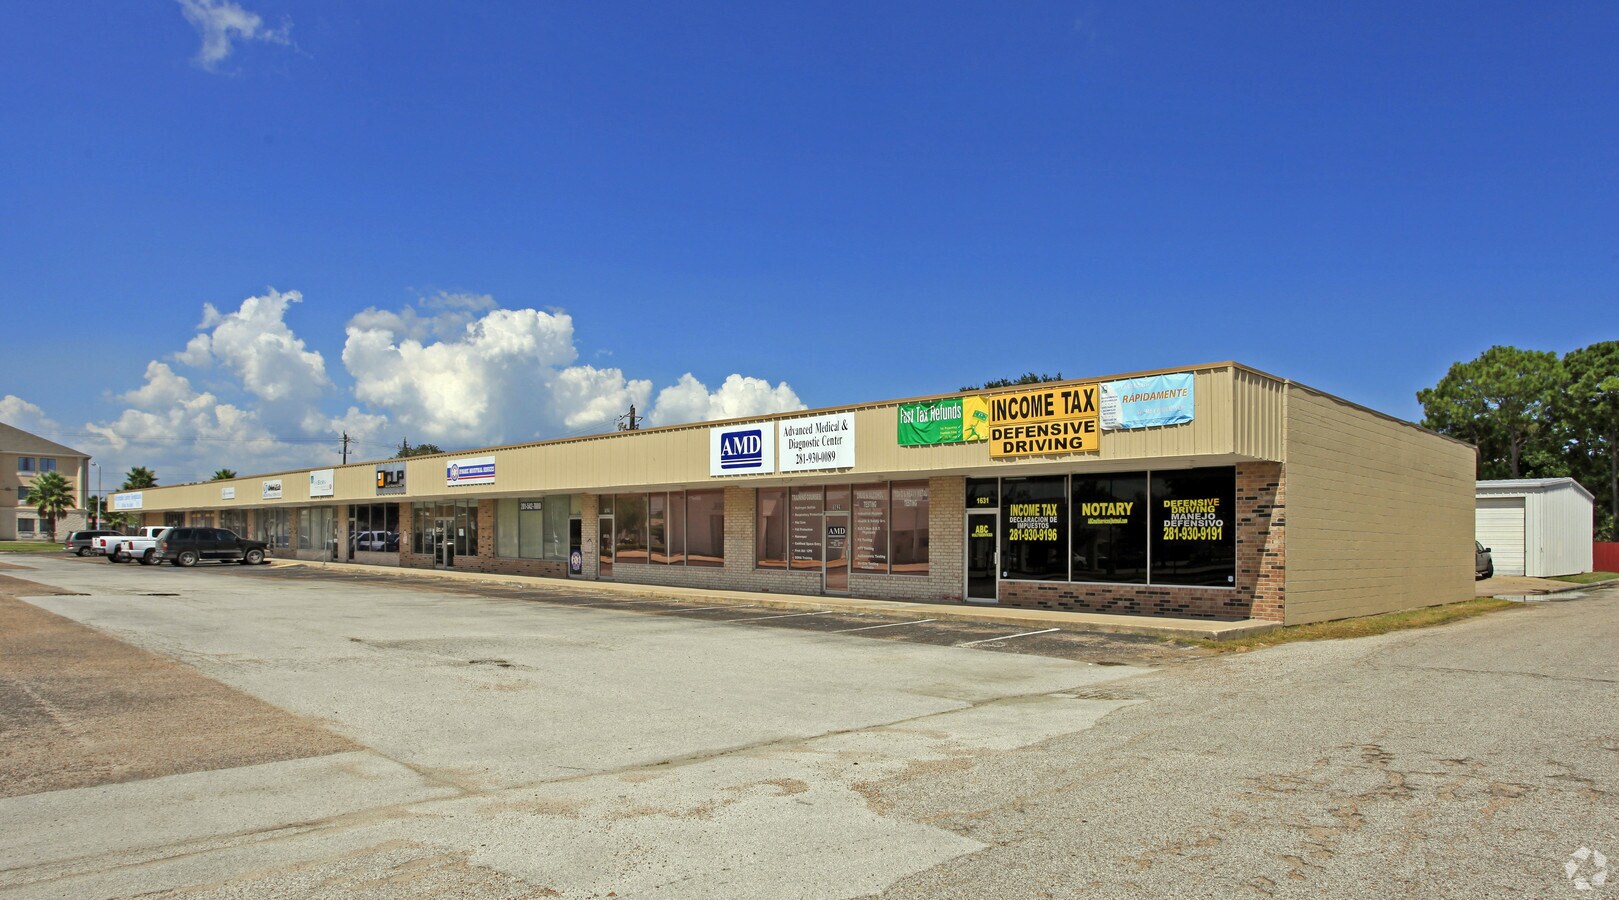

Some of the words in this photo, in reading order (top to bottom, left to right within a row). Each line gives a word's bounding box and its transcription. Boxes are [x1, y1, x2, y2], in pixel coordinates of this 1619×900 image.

[1122, 388, 1188, 403] RÁPIDAMENTE
[992, 393, 1054, 421] INCOME
[1061, 388, 1095, 414] TAX
[900, 408, 914, 424] Fast
[916, 406, 928, 422] Tax
[930, 403, 962, 421] Refunds
[784, 423, 813, 437] Advanced
[815, 421, 840, 434] Medical
[841, 419, 848, 431] &
[992, 420, 1095, 440] DEFENSIVE
[721, 435, 761, 456] AMD
[788, 436, 820, 451] Diagnostic
[822, 434, 842, 446] Center
[1004, 437, 1082, 453] DRIVING
[796, 451, 835, 464] 281-930-0089
[1010, 504, 1040, 516] INCOME
[1042, 504, 1057, 516] TAX
[1082, 502, 1133, 516] NOTARY
[1164, 498, 1220, 507] DEFENSIVE
[975, 525, 989, 533] ABC
[1009, 529, 1057, 541] 281-930-9196
[1163, 527, 1222, 540] 281-930-9191
